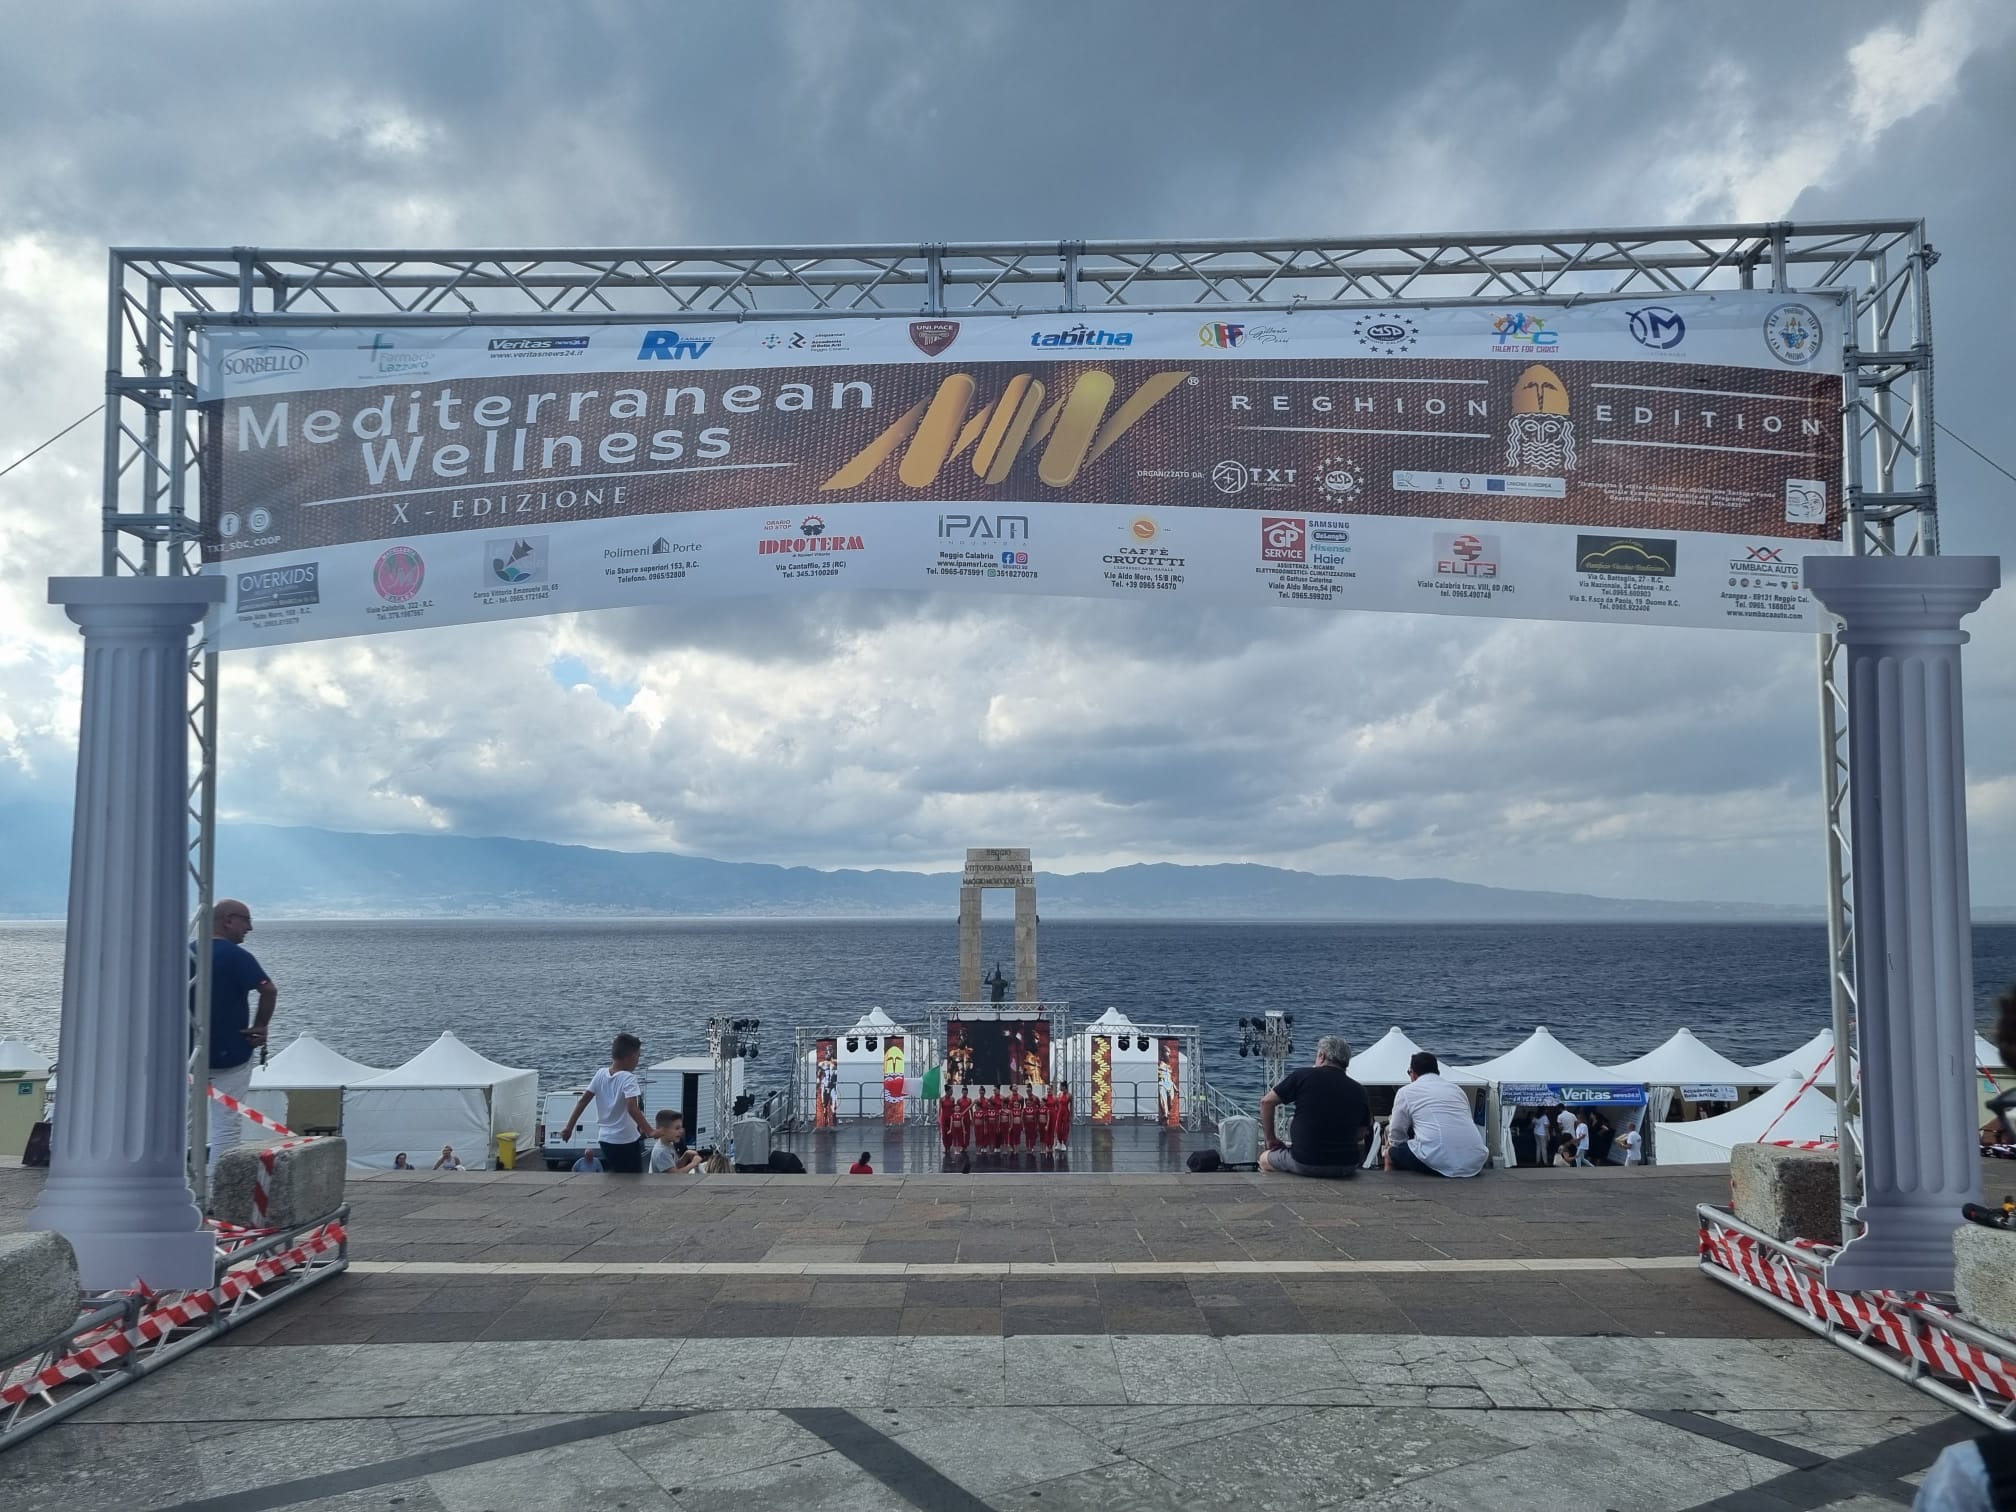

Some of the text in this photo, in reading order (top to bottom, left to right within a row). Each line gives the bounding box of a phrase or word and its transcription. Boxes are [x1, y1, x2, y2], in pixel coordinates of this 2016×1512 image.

[492, 339, 552, 350] Veritas
[1031, 329, 1134, 347] tabitha
[223, 353, 304, 375] SORBELLO
[1231, 395, 1487, 416] REGHION
[238, 381, 873, 451] Mediterranean
[1596, 405, 1821, 435] EDITION
[362, 427, 731, 485] Wellness
[1137, 470, 1190, 478] ORGANIZZATO
[1250, 468, 1297, 482] TXT
[392, 502, 410, 524] X
[452, 486, 627, 518] EDIZIONE
[938, 513, 1029, 539] IPAM
[1308, 520, 1350, 529] SAMSUNG
[207, 536, 281, 553] TXT_SOC_COOP
[759, 535, 865, 554] IDROTERM
[1268, 528, 1299, 548] GP
[604, 542, 702, 558] Polimeni Porte
[1119, 546, 1169, 556] CAFFÈ
[1264, 548, 1303, 558] SERVICE
[1310, 543, 1352, 552] Hisense
[940, 551, 994, 560] Reggio Calabria
[1102, 555, 1185, 567] CRUCITTI
[1313, 553, 1345, 564] Haier
[617, 567, 639, 575] Sbarre
[640, 563, 669, 573] superiori
[686, 560, 699, 569] R.C.
[776, 563, 787, 571] Via
[832, 560, 847, 569] (RC)
[926, 567, 939, 575] Tel.
[937, 561, 999, 569] www.ipamsrl.com
[1729, 562, 1774, 573] VUMBACA
[1775, 566, 1799, 575] AUTO
[240, 566, 314, 592] OVERKIDS
[783, 571, 795, 579] Tel.
[1103, 571, 1116, 579] V.le
[1118, 572, 1133, 580] Aldo
[1134, 573, 1153, 582] Moro,
[1170, 575, 1185, 584] (RC)
[1111, 580, 1124, 588] Tel.
[1286, 582, 1300, 590] Aldo
[1329, 585, 1343, 593] (RC)
[1417, 580, 1434, 588] Viale
[1435, 581, 1460, 589] Calabria
[1502, 584, 1515, 593] (RC)
[1561, 1087, 1612, 1101] Veritas
